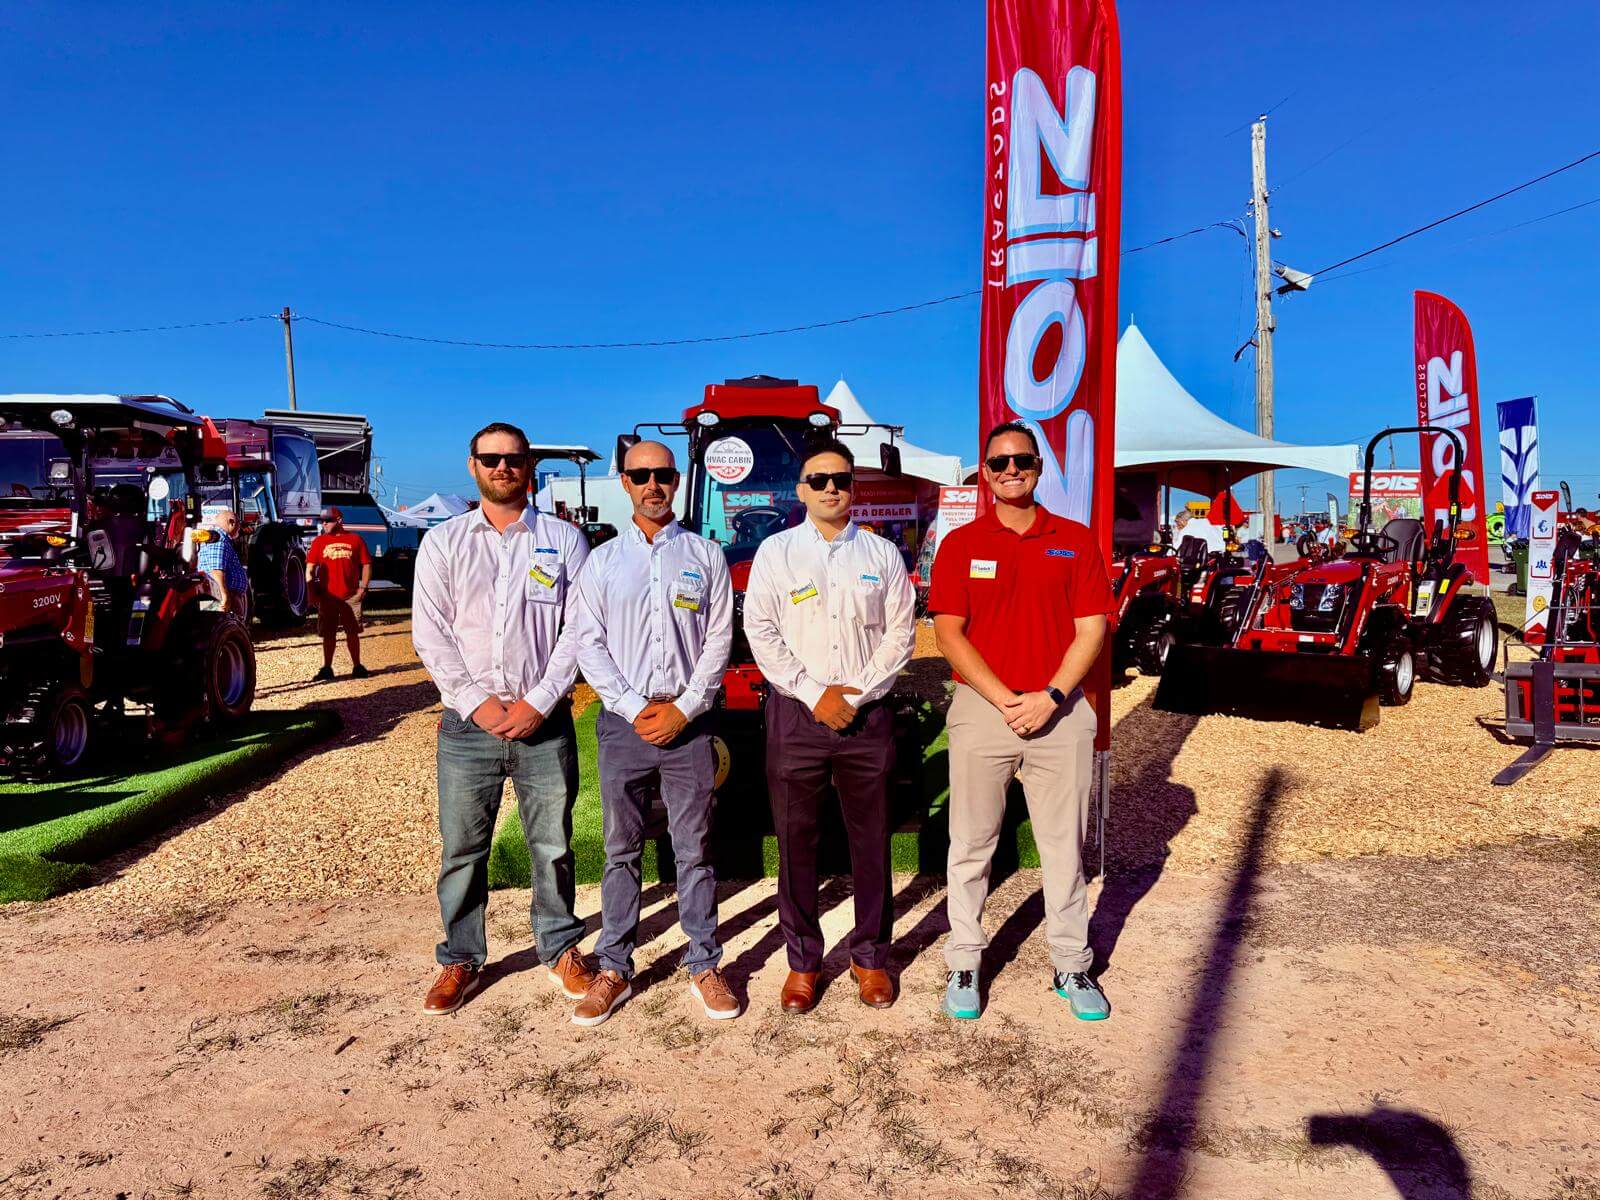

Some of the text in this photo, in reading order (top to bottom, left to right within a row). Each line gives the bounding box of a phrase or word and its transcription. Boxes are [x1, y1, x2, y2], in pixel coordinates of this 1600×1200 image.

[706, 455, 752, 464] HVAC CABIN
[862, 508, 869, 517] A
[871, 507, 912, 517] DEALER
[32, 593, 62, 608] 3200V
